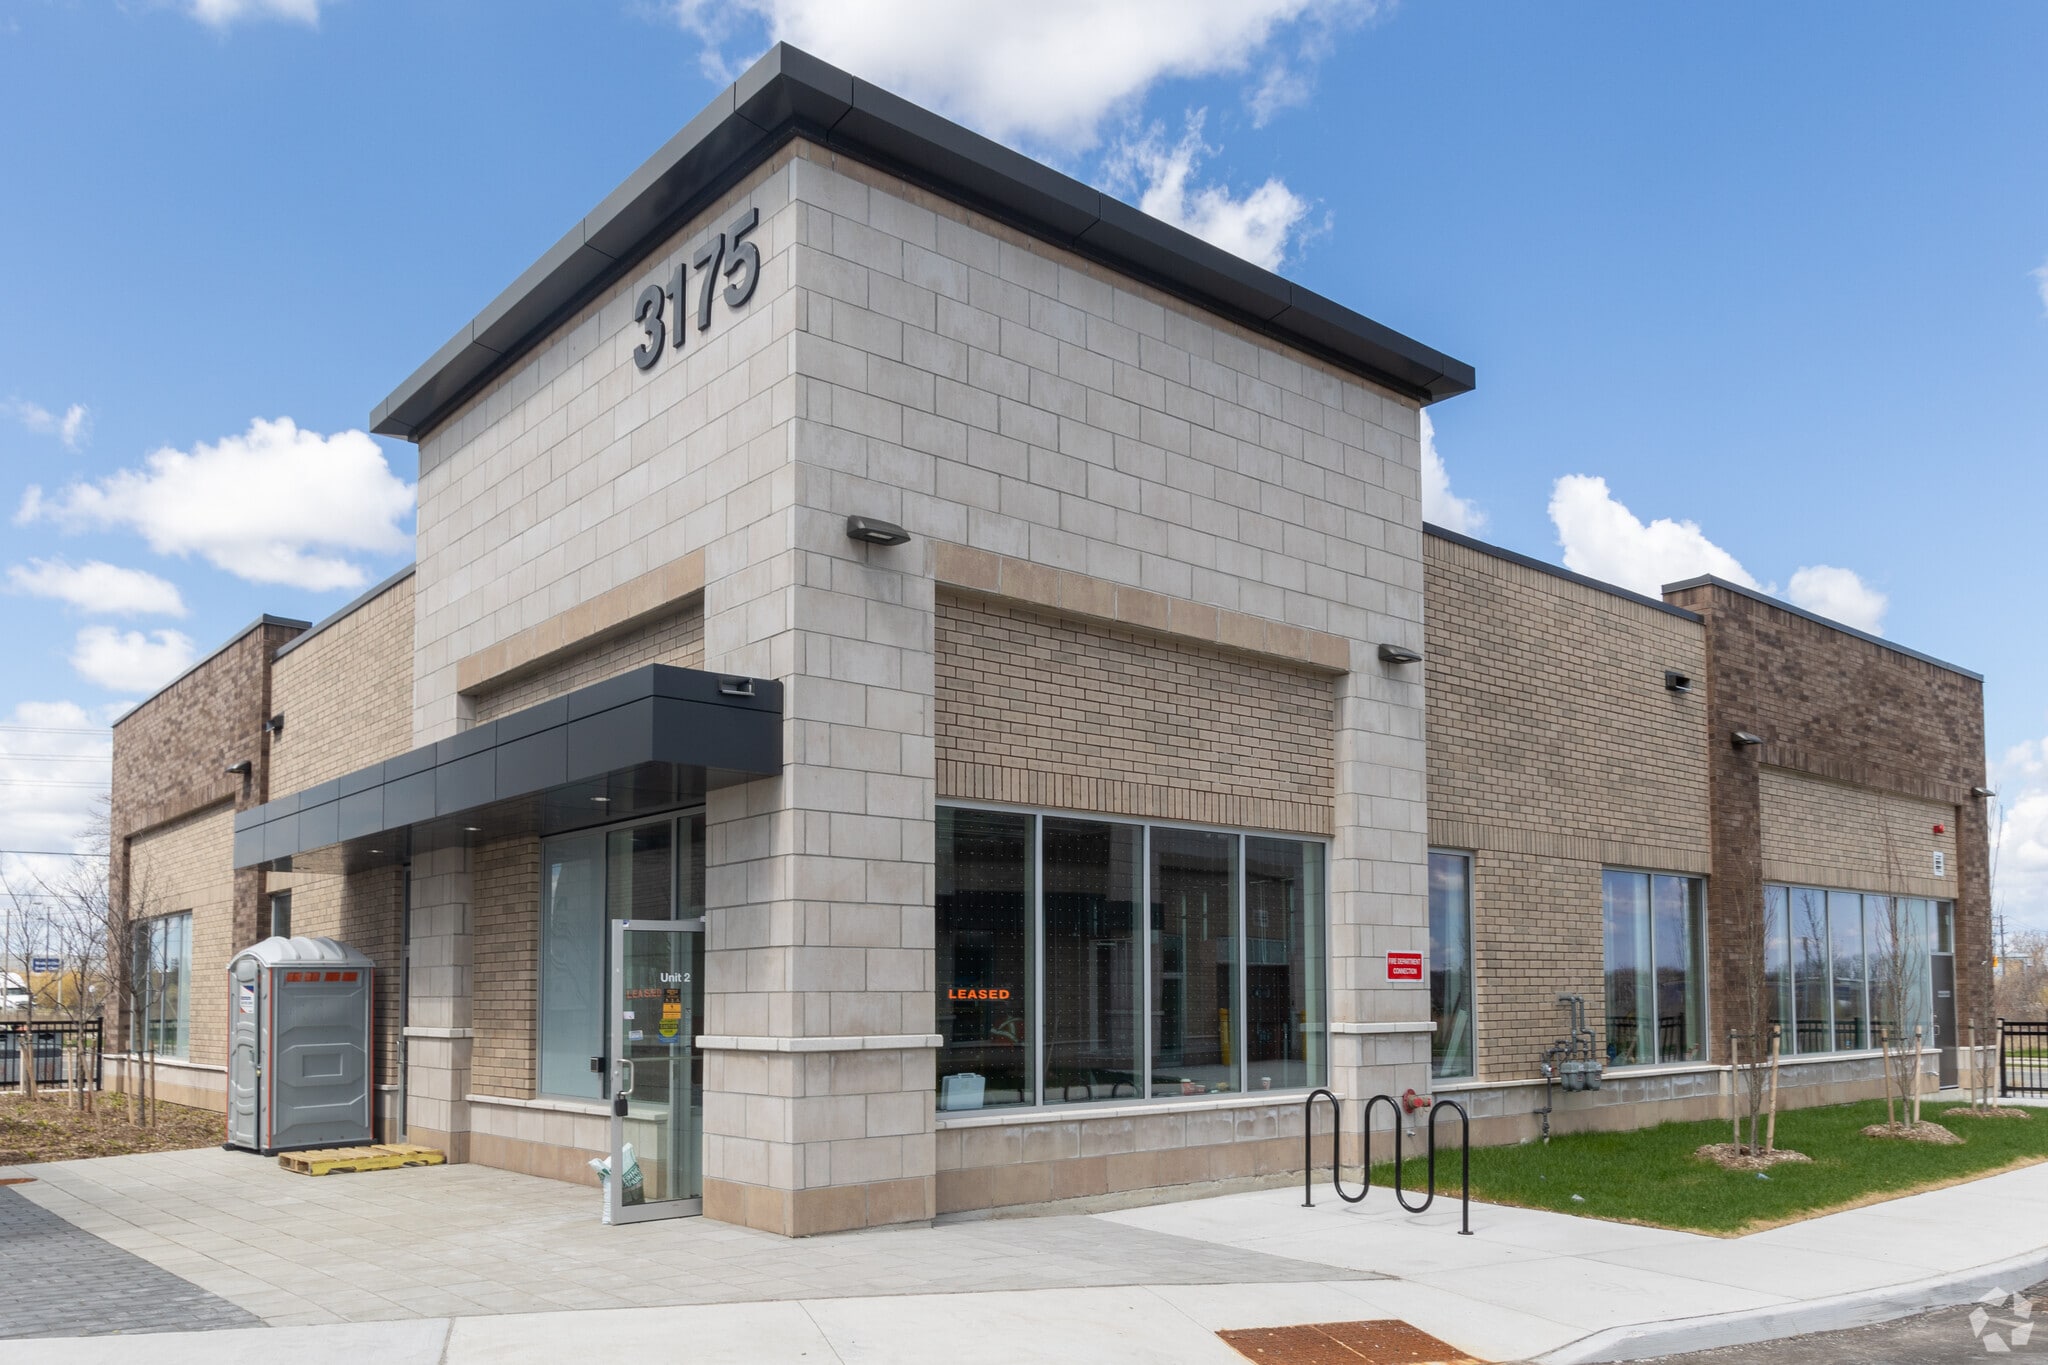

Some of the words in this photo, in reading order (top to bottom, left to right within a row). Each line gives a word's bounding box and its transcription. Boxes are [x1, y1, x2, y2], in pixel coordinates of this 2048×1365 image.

[634, 208, 760, 370] 3175
[660, 972, 682, 983] Unit
[683, 972, 691, 983] 2
[626, 988, 662, 999] LEASED
[948, 989, 1010, 999] LEASED
